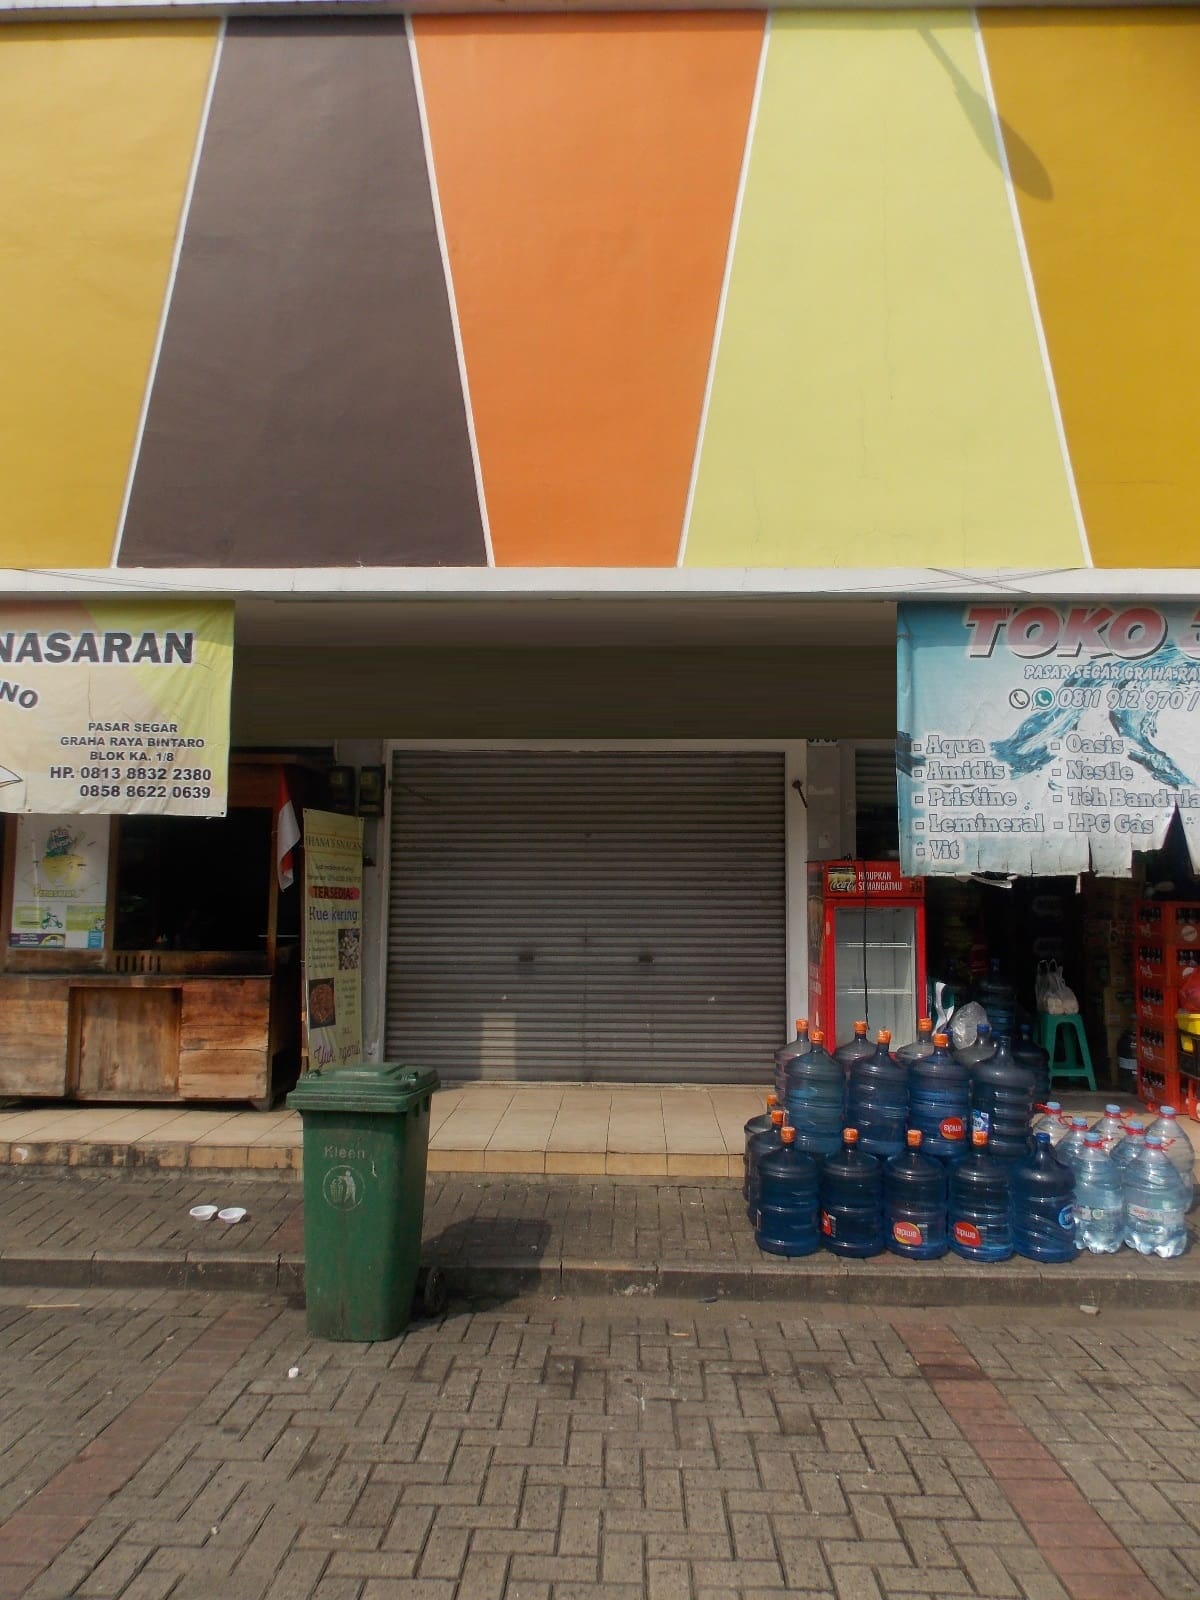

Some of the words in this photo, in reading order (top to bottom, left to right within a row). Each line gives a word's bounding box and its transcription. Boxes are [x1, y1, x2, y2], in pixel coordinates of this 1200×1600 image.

[966, 605, 1168, 660] TOKO
[1024, 664, 1071, 680] PASAR
[1073, 664, 1120, 681] SEGAR
[1175, 666, 1200, 682] RA
[1058, 688, 1101, 709] 0811
[1106, 689, 1141, 710] 912
[1144, 690, 1184, 711] 970
[88, 722, 130, 732] PASAR
[134, 723, 178, 733] SEGAR
[60, 736, 106, 746] GRAHA
[110, 737, 143, 747] RAYA
[147, 738, 205, 748] BINTARO
[926, 735, 985, 759] Aqua
[1066, 733, 1124, 754] Oasis
[89, 751, 125, 761] BLOK
[129, 752, 152, 761] KA.
[156, 752, 174, 762] 1/8
[50, 766, 75, 779] HP.
[80, 767, 121, 780] 0813
[126, 767, 167, 781] 8832
[172, 768, 212, 781] 2380
[927, 760, 1005, 780] Amidis
[1066, 760, 1134, 781] Nestle
[79, 785, 120, 798] 0858
[126, 785, 167, 798] 8622
[172, 786, 211, 800] 0639
[928, 787, 1018, 807] Pristine
[1067, 787, 1108, 806] Teh
[929, 813, 1045, 833] Lemineral
[1068, 813, 1111, 833] LPG
[1114, 813, 1154, 834] Gas
[929, 840, 960, 860] Vit
